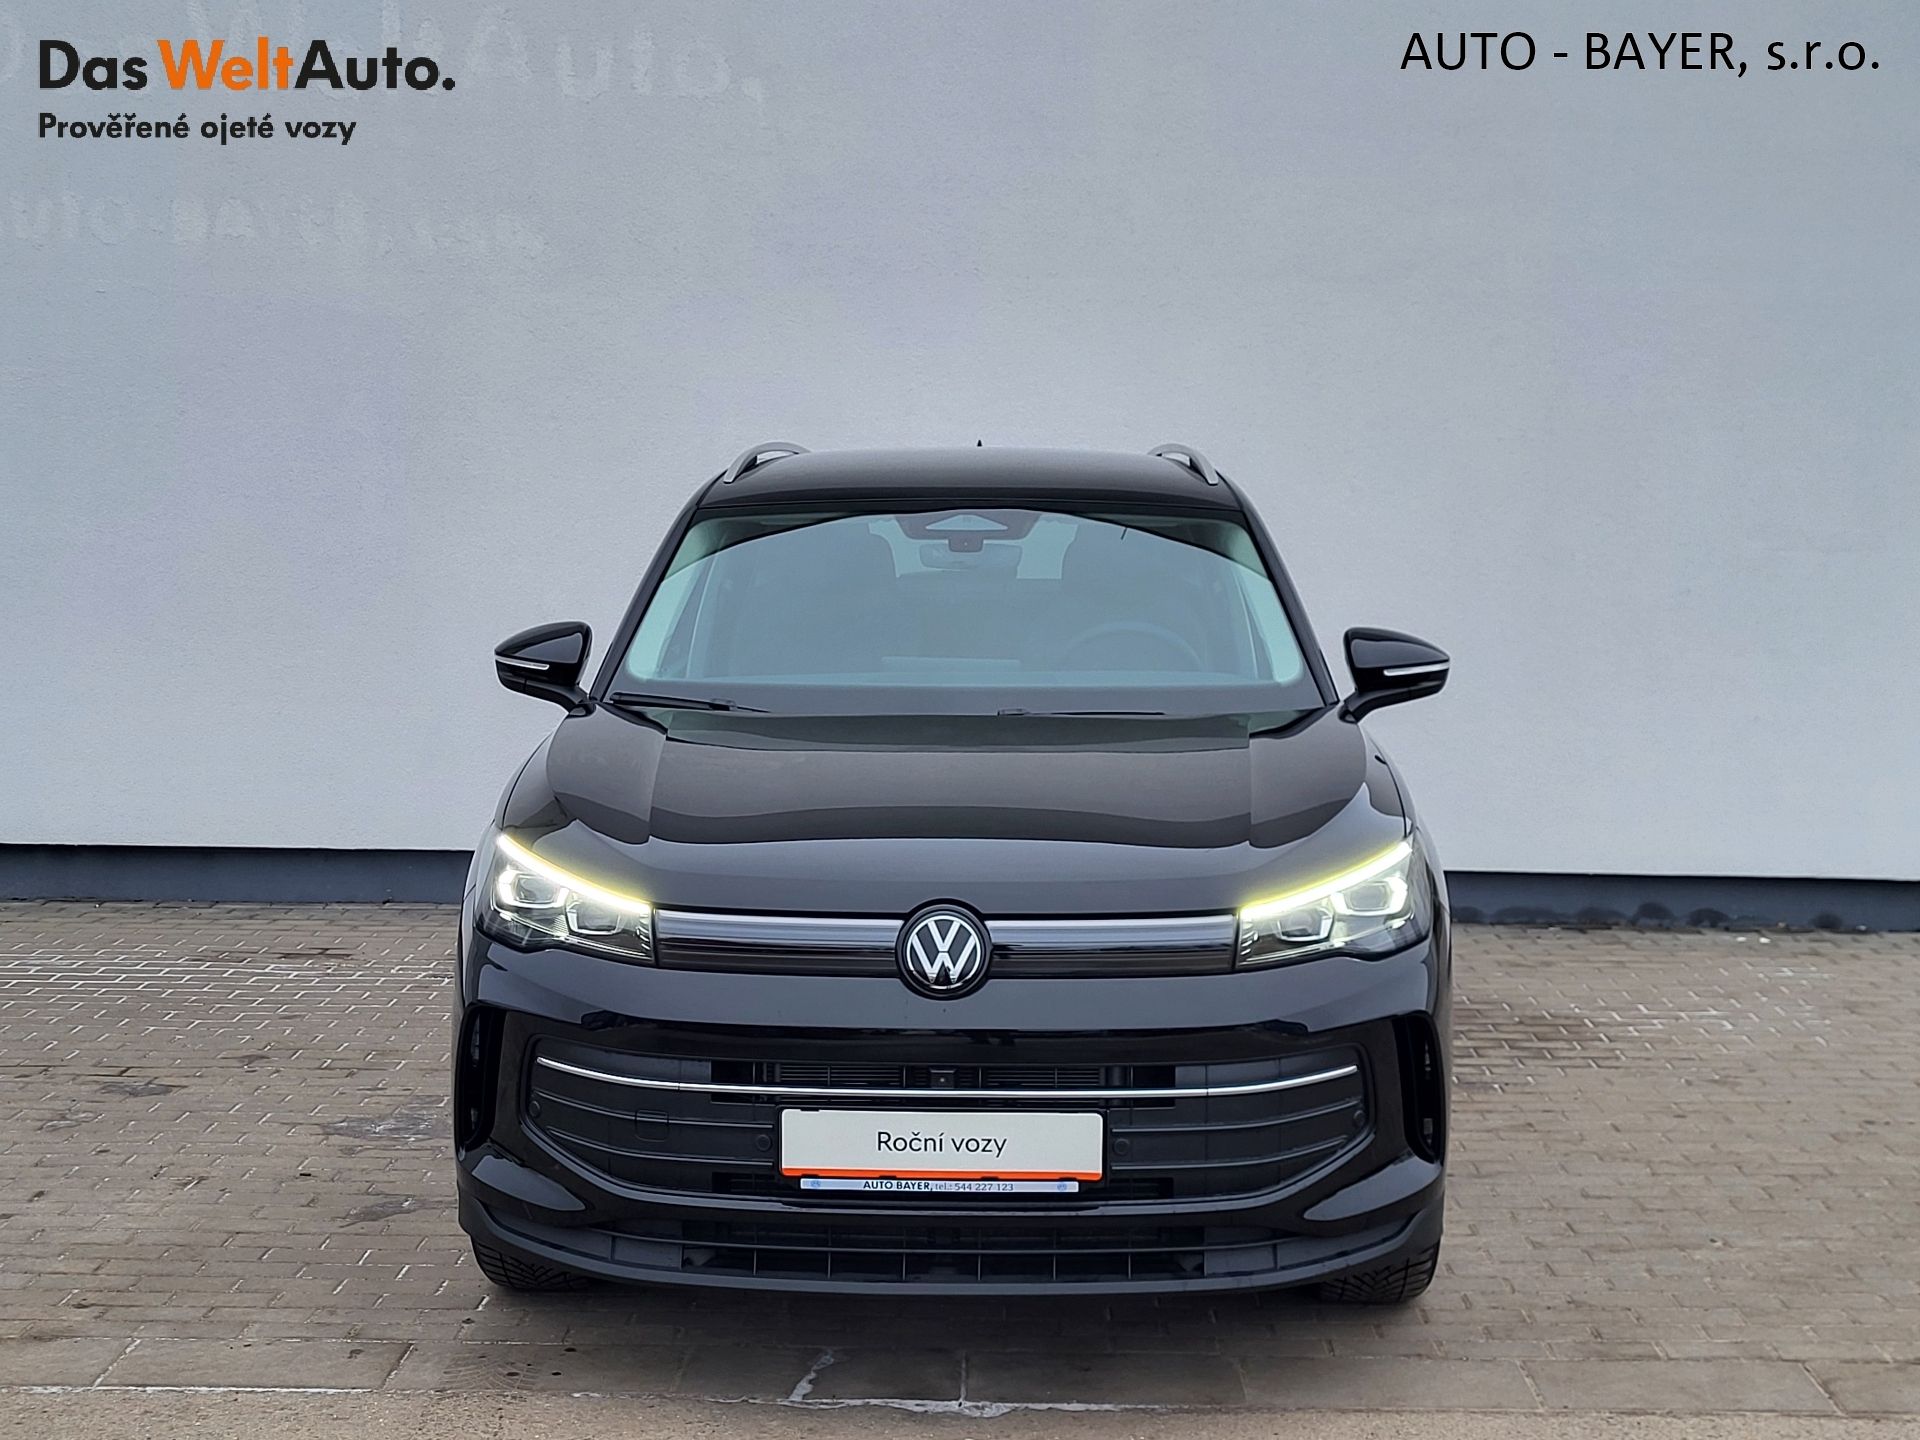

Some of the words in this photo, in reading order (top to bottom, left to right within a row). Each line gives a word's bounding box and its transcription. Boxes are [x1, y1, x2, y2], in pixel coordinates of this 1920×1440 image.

[878, 1132, 944, 1152] Roční
[951, 1138, 1006, 1157] vozy
[863, 1181, 893, 1190] AUTO
[896, 1181, 933, 1191] BAYER,
[955, 1182, 972, 1191] 544
[975, 1183, 993, 1191] 227
[997, 1183, 1014, 1192] 123
